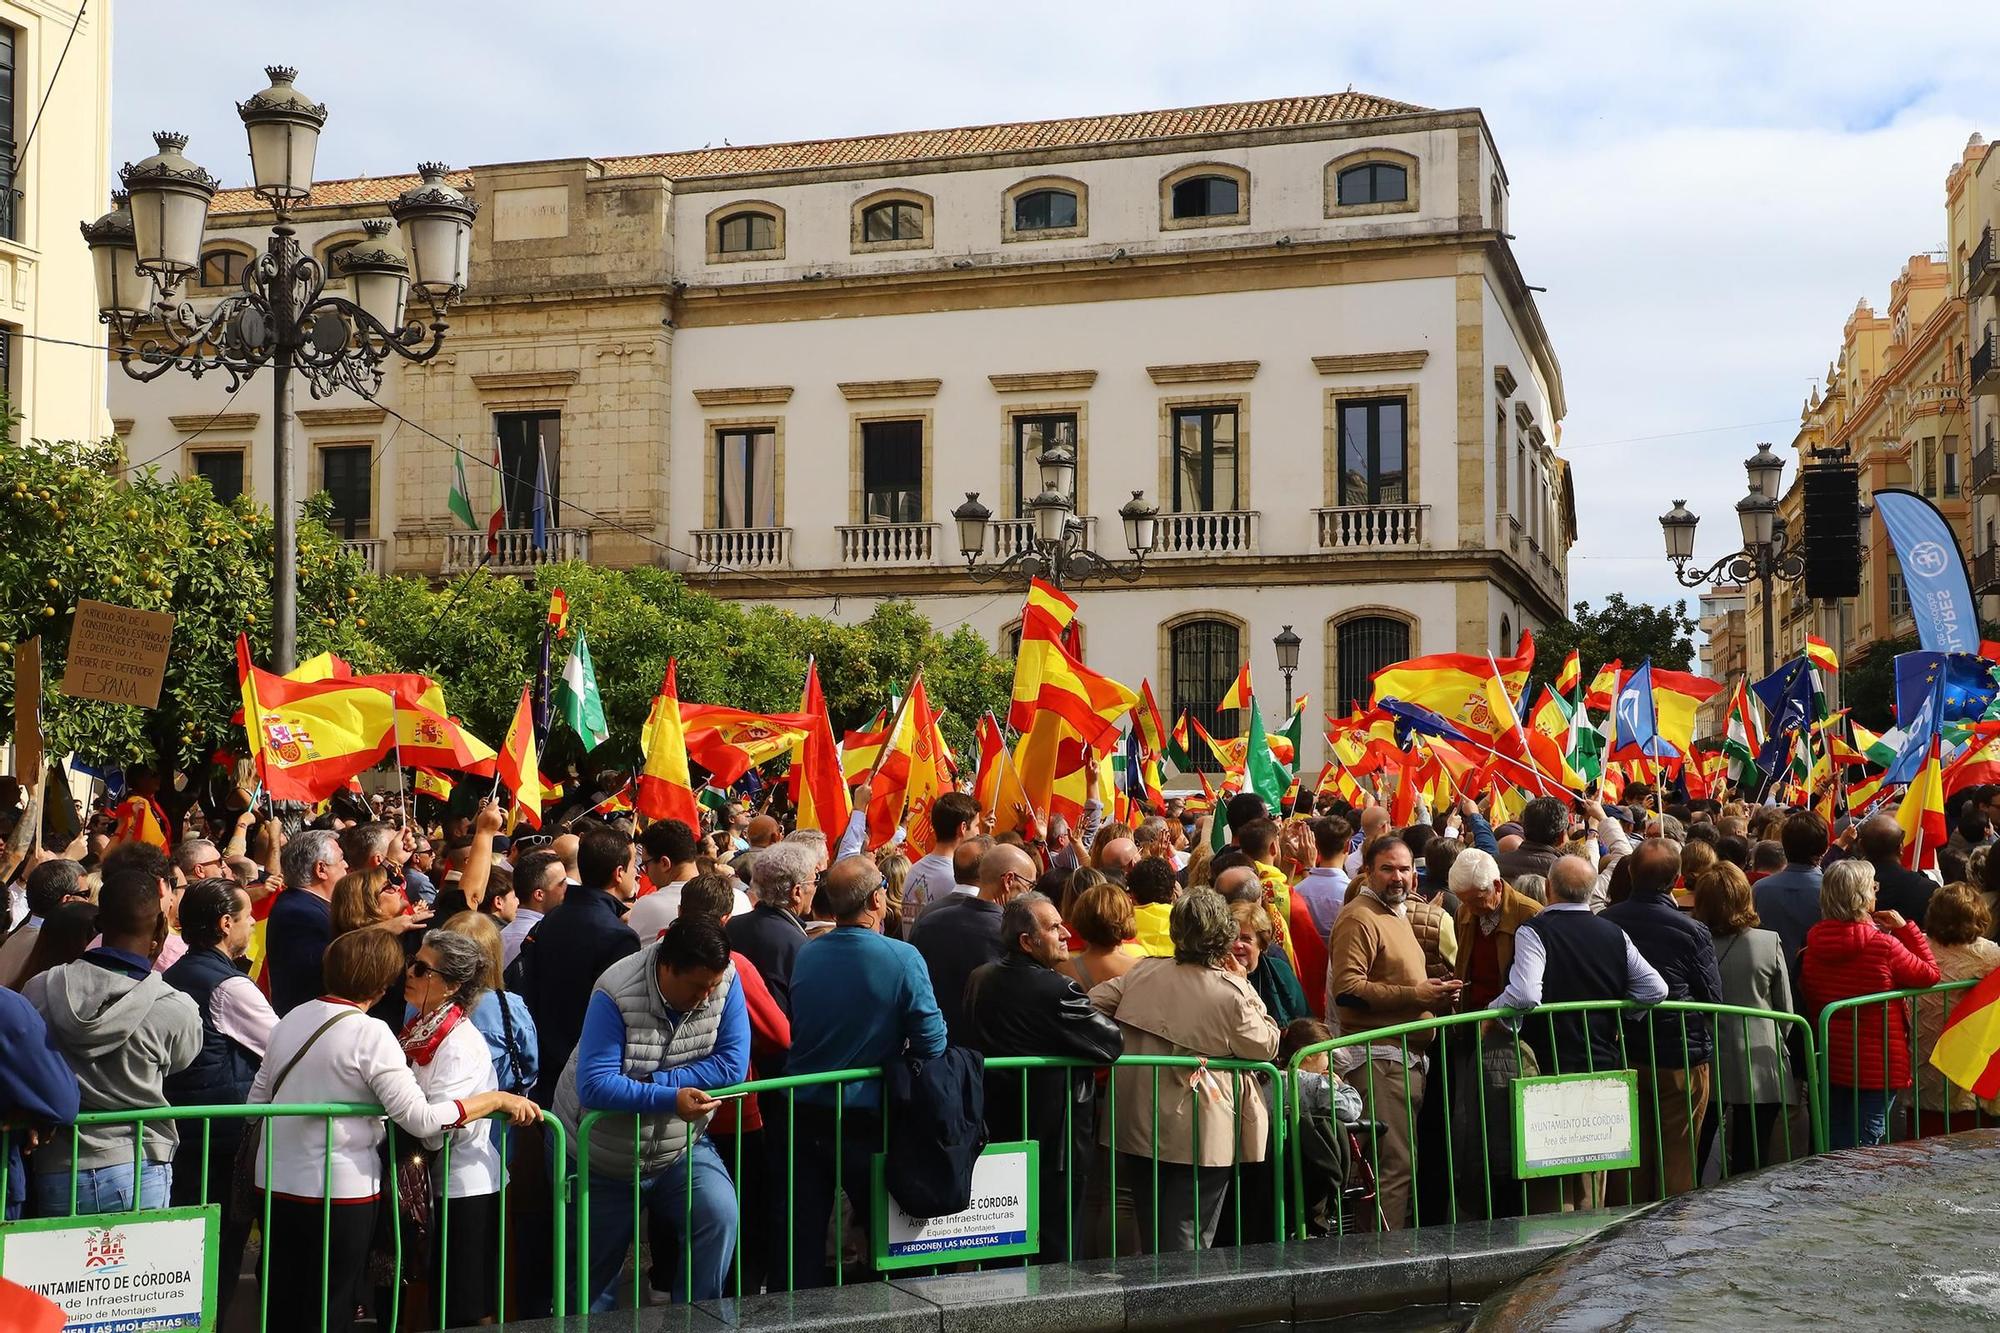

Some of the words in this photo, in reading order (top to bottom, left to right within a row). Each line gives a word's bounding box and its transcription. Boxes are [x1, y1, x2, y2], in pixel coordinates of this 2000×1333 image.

[129, 616, 140, 625] DE
[140, 618, 150, 627] LA
[76, 641, 86, 650] EL
[89, 643, 126, 657] DERECHO
[79, 629, 94, 640] LOS
[141, 640, 165, 654] TIENEN
[74, 655, 97, 668] DEBER
[100, 660, 113, 670] DE
[116, 663, 154, 677] DEFENDER
[1531, 1119, 1582, 1132] AYUNTAMIENTO
[1583, 1118, 1591, 1127] DE
[1560, 1135, 1568, 1144] de
[1542, 1157, 1573, 1167] PERDONEN
[1574, 1155, 1585, 1163] LAS
[1586, 1152, 1617, 1162] MOLESTIAS
[978, 1195, 1019, 1210] CÓRDOBA
[932, 1216, 944, 1226] de
[946, 1210, 1015, 1224] Infraestructuras
[927, 1227, 951, 1238] Equipo
[953, 1226, 963, 1235] de
[964, 1224, 996, 1234] Montajes
[902, 1241, 943, 1253] PERDONEN
[944, 1239, 958, 1249] LAS
[960, 1235, 999, 1247] MOLESTIAS
[113, 1275, 129, 1290] DE
[132, 1270, 191, 1288] CÓRDOBA
[65, 1297, 81, 1310] de
[86, 1289, 185, 1308] Infraestructuras
[95, 1310, 108, 1320] de
[111, 1306, 157, 1319] Montajes
[90, 1324, 113, 1333] LAS
[116, 1317, 182, 1333] MOLESTIAS
